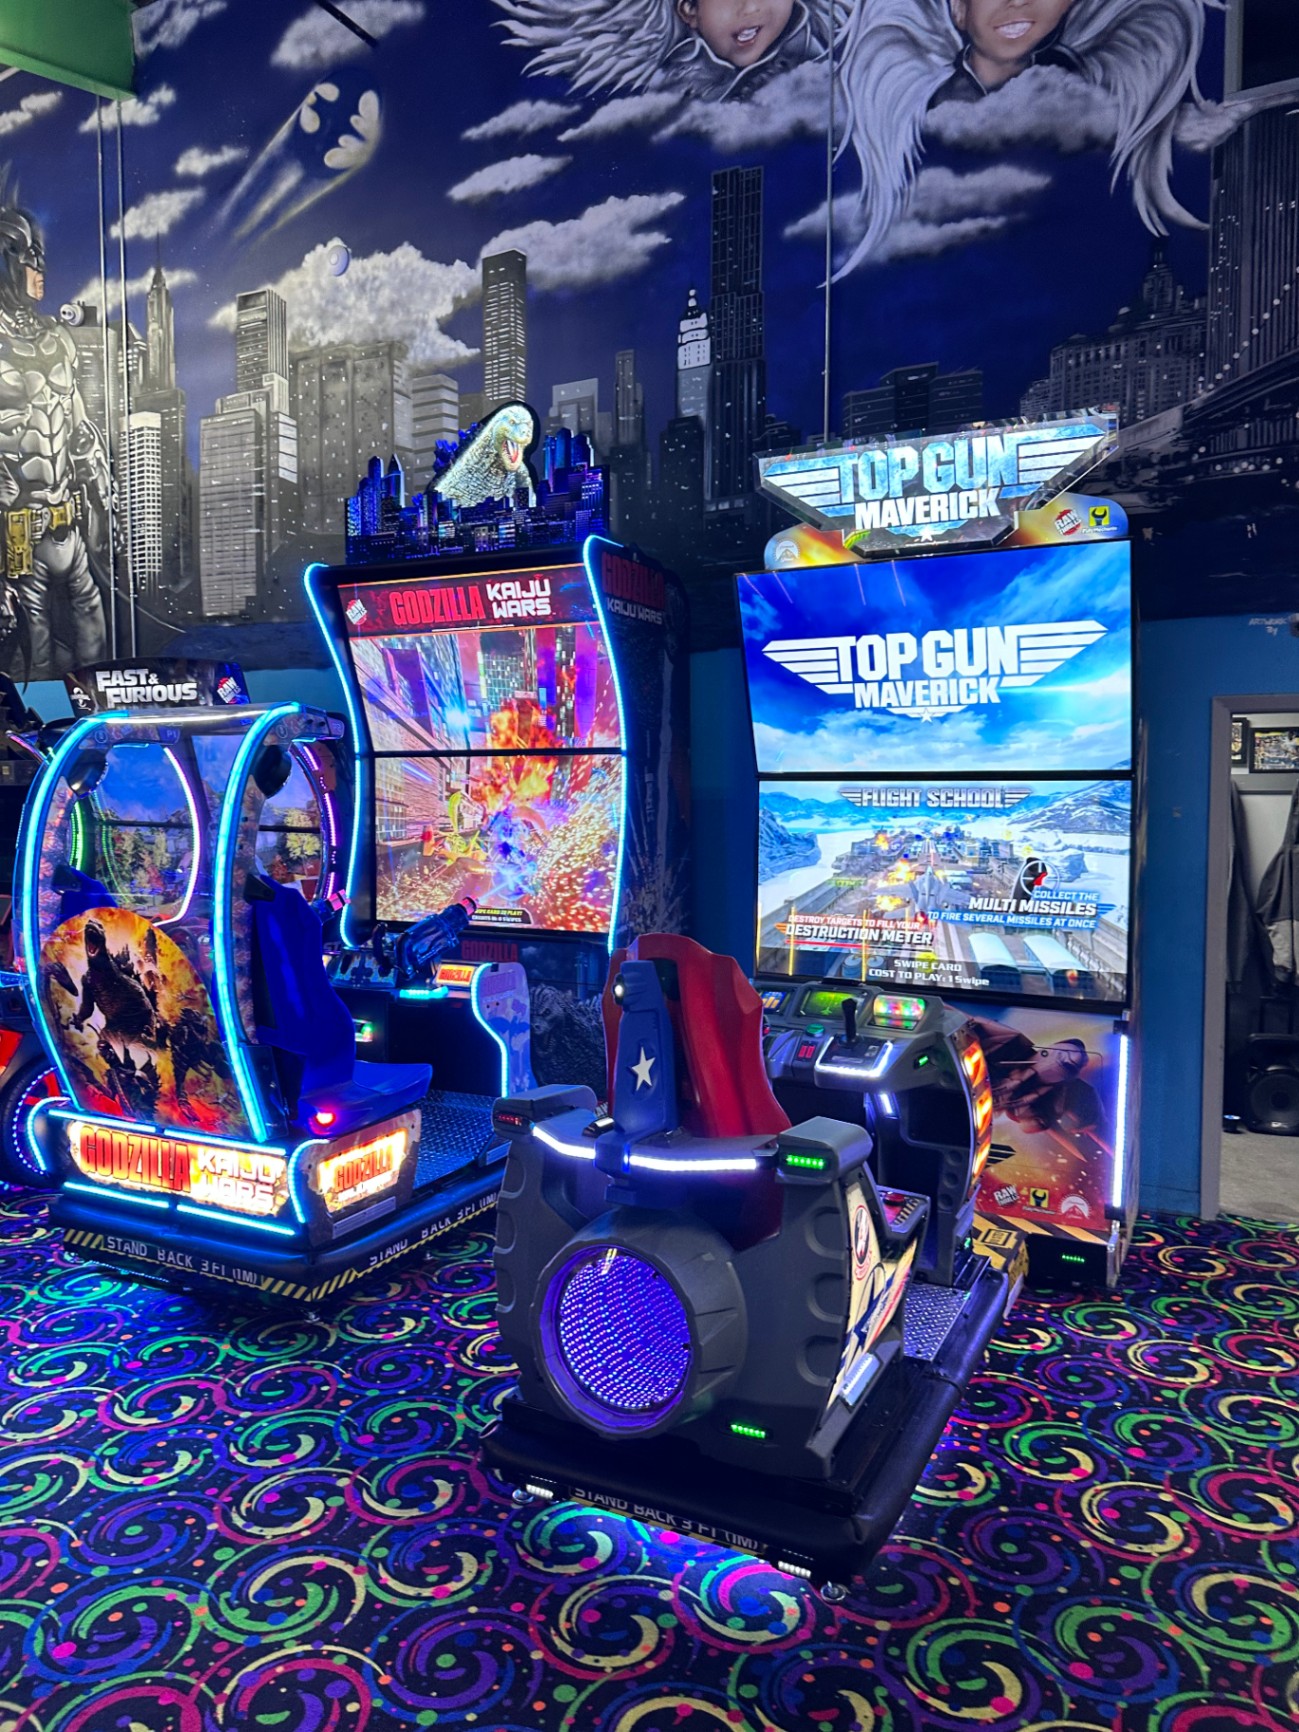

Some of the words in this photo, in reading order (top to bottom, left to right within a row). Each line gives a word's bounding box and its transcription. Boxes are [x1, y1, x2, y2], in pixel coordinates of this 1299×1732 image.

[838, 446, 919, 503] TOP
[922, 435, 1018, 493] GUN
[855, 487, 1001, 529] MAVERICK
[1054, 508, 1080, 530] RAW
[486, 578, 551, 601] KAIJU
[389, 585, 486, 626] GODZILLA
[491, 597, 552, 619] WARS
[607, 597, 636, 618] KAIJU
[638, 605, 663, 625] WARS
[838, 632, 918, 682] TOP
[921, 626, 1018, 678] GUN
[96, 669, 149, 692] FAST
[148, 673, 159, 685] &
[105, 683, 198, 709] FURIOUS
[854, 676, 1001, 709] MAVERICK
[862, 787, 922, 808] FLIGHT
[927, 787, 1004, 809] SCHOOL
[968, 897, 1016, 912] MULTI
[1018, 900, 1097, 916] MISSILES
[1034, 890, 1077, 901] COLLECT
[1080, 892, 1099, 901] THE
[788, 914, 825, 925] DESTROY
[827, 916, 863, 927] TARGETS
[865, 918, 876, 927] TO
[876, 919, 893, 928] FILL
[893, 920, 920, 930] YOUR
[928, 911, 939, 920] TO
[941, 912, 962, 921] FIRE
[963, 914, 1005, 924] SEVERAL
[1006, 916, 1052, 926] MISSILES
[1053, 919, 1066, 927] AT
[1068, 920, 1097, 929] ONCE
[785, 924, 882, 942] DESTRUCTION
[882, 929, 932, 945] METER
[462, 940, 518, 961] GODZILLA
[894, 959, 930, 970] SWIPE
[932, 962, 962, 973] CARD
[868, 969, 895, 978] COST
[898, 970, 913, 980] TO
[914, 972, 946, 983] PLAY:
[948, 974, 953, 983] 1
[954, 976, 990, 987] Swipe
[80, 1125, 192, 1194] GODZILLA
[199, 1149, 280, 1185] KAIJU
[334, 1145, 394, 1194] GODZILLA
[993, 1184, 1018, 1202] RAW
[107, 1236, 148, 1257] STAND
[157, 1248, 193, 1268] BACK
[575, 1487, 629, 1511] STAND
[633, 1504, 677, 1527] BACK
